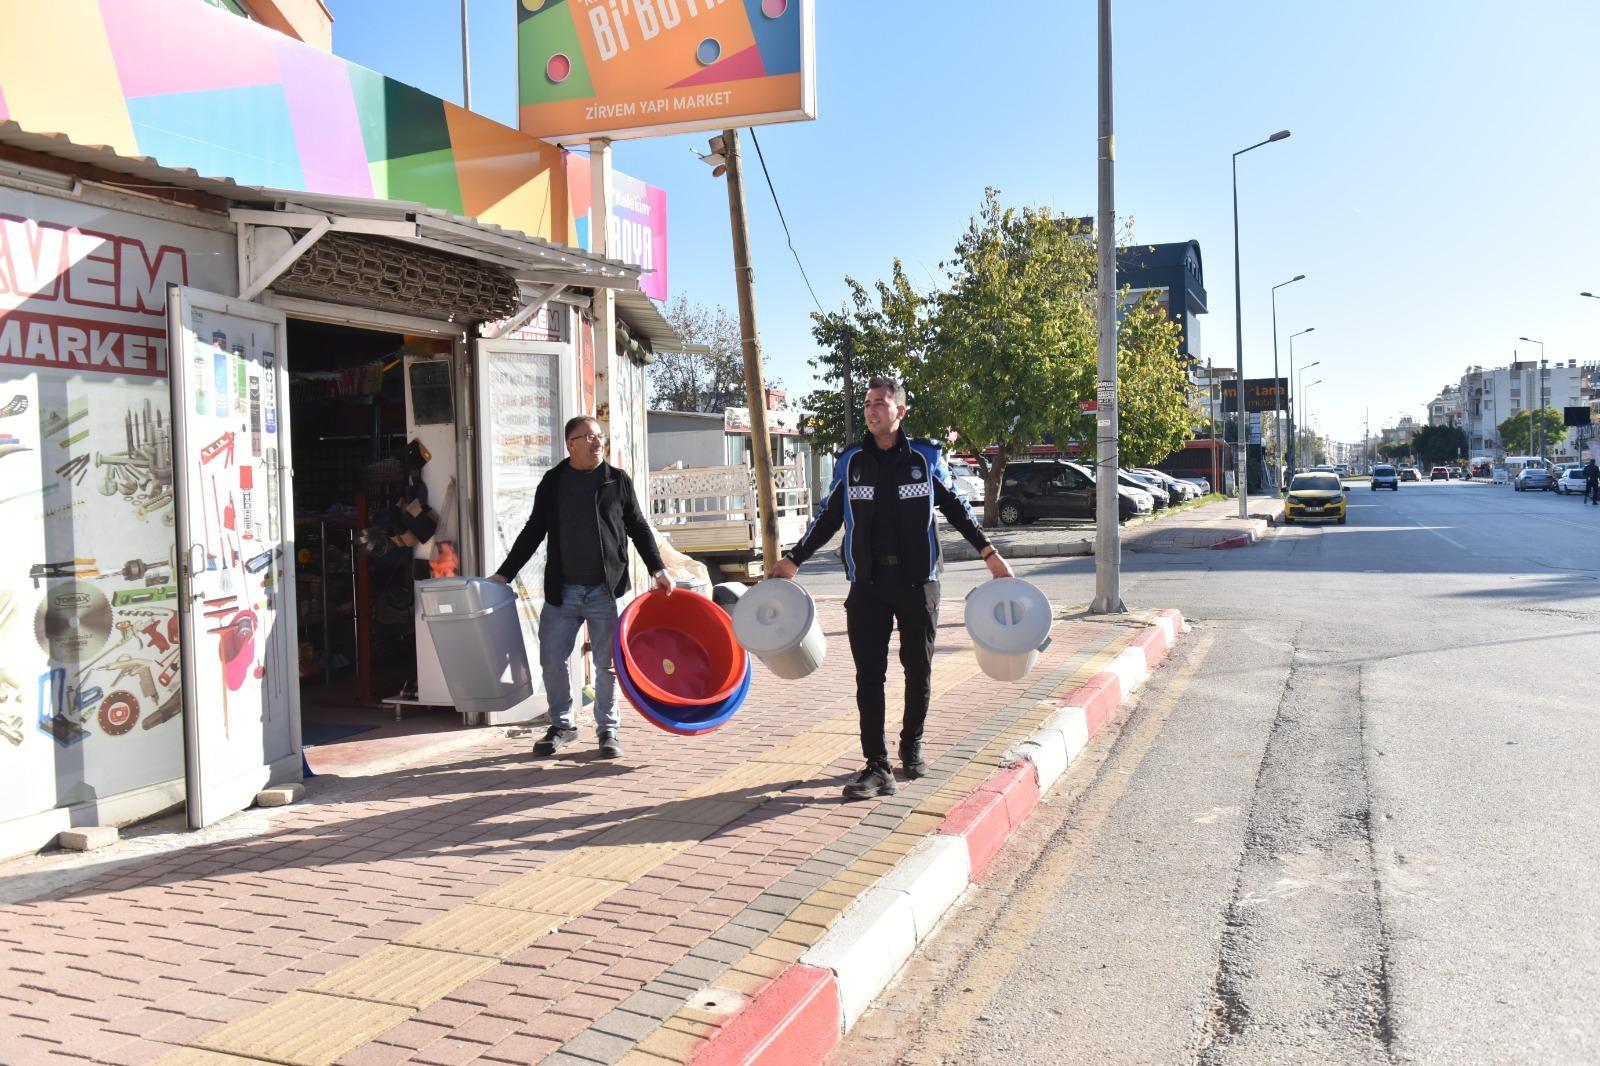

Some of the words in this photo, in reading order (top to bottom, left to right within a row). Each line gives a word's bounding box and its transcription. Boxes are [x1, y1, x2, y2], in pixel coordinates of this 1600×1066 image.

[585, 102, 635, 120] ZİRVEM
[639, 98, 669, 114] YAPI
[673, 91, 732, 111] MARKET
